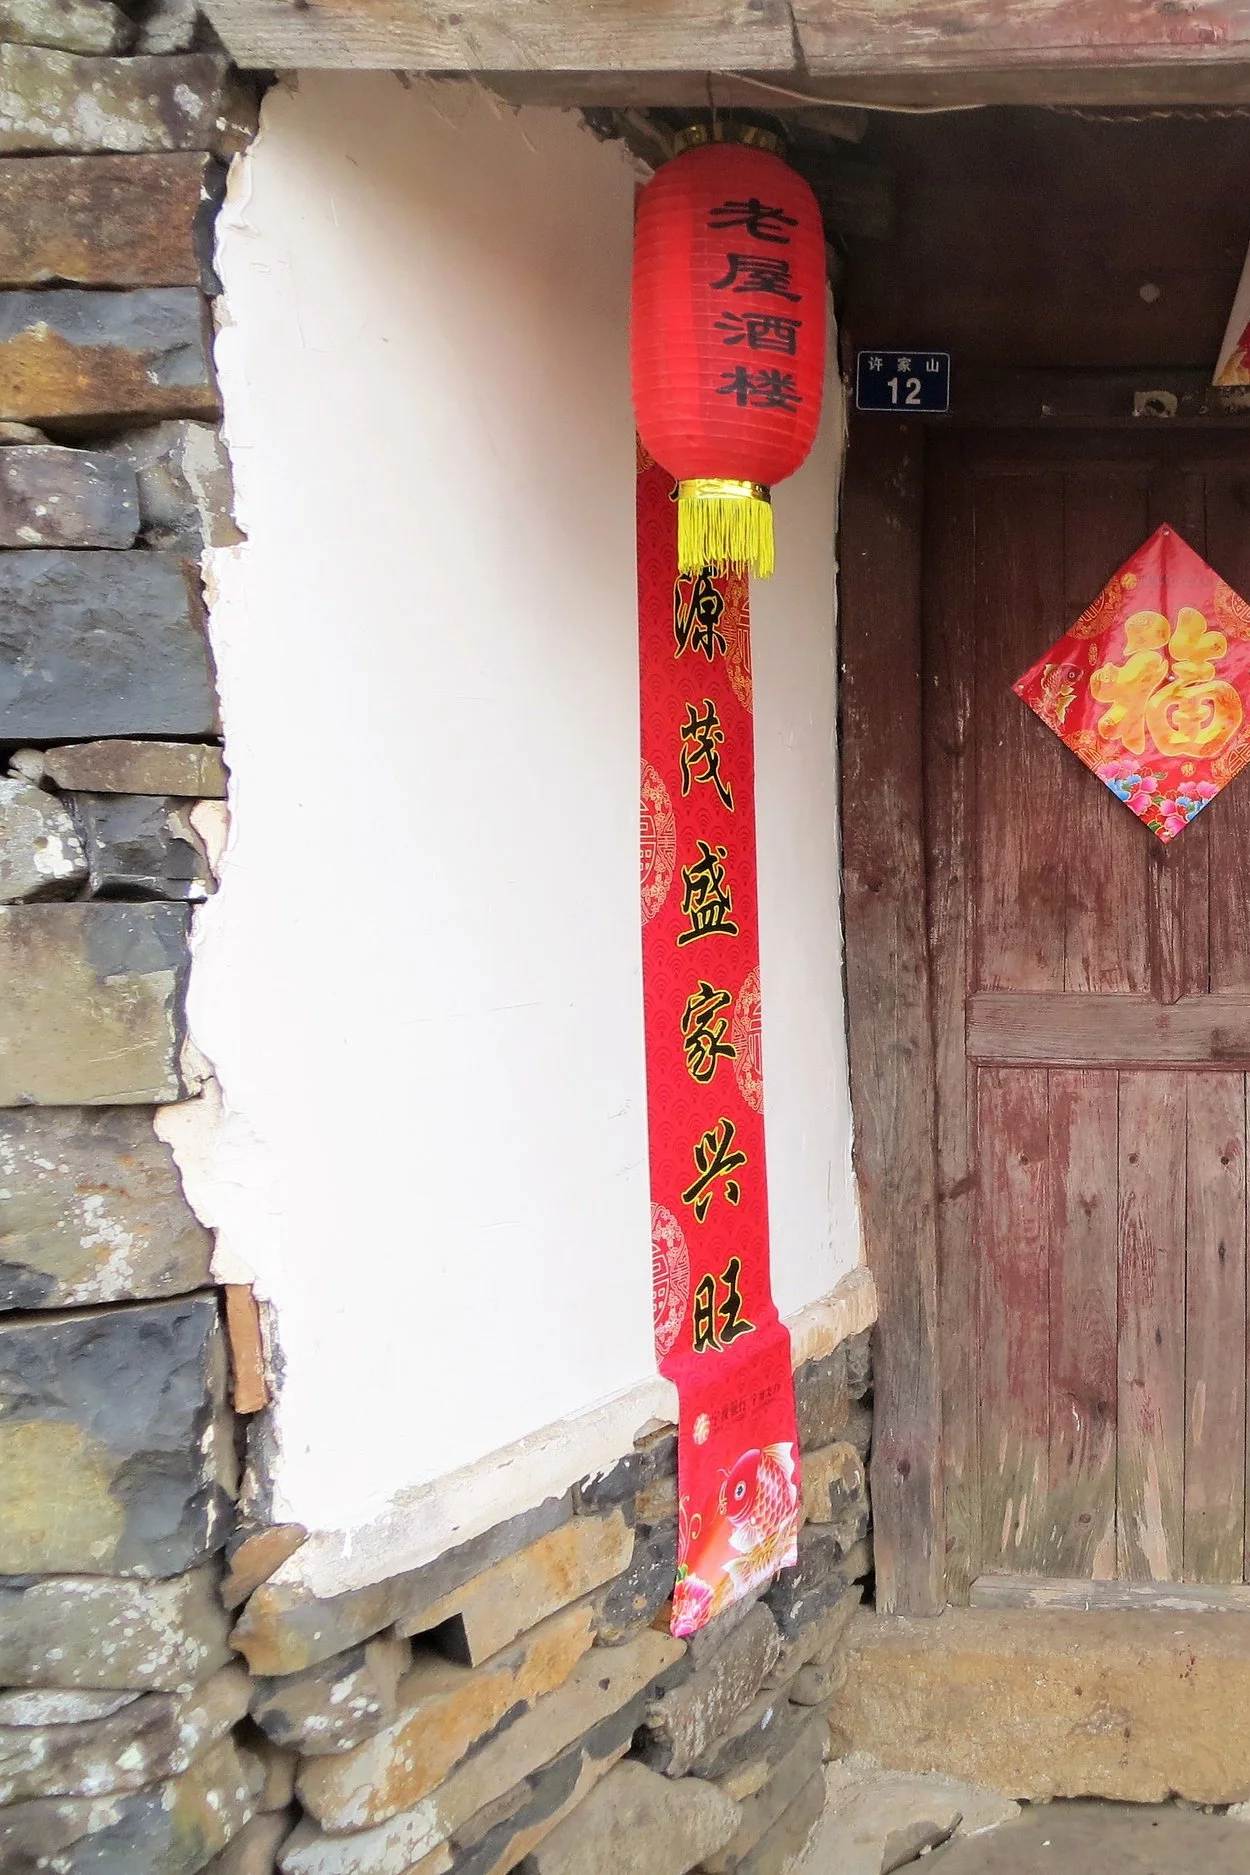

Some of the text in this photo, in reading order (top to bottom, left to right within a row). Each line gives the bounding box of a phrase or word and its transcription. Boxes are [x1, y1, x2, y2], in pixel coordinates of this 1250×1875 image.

[708, 197, 804, 412] 老屋酒楼
[868, 356, 939, 373] 许家山
[887, 377, 922, 405] 12
[1090, 606, 1244, 759] 福
[669, 480, 757, 1355] 源茂盛家兴旺
